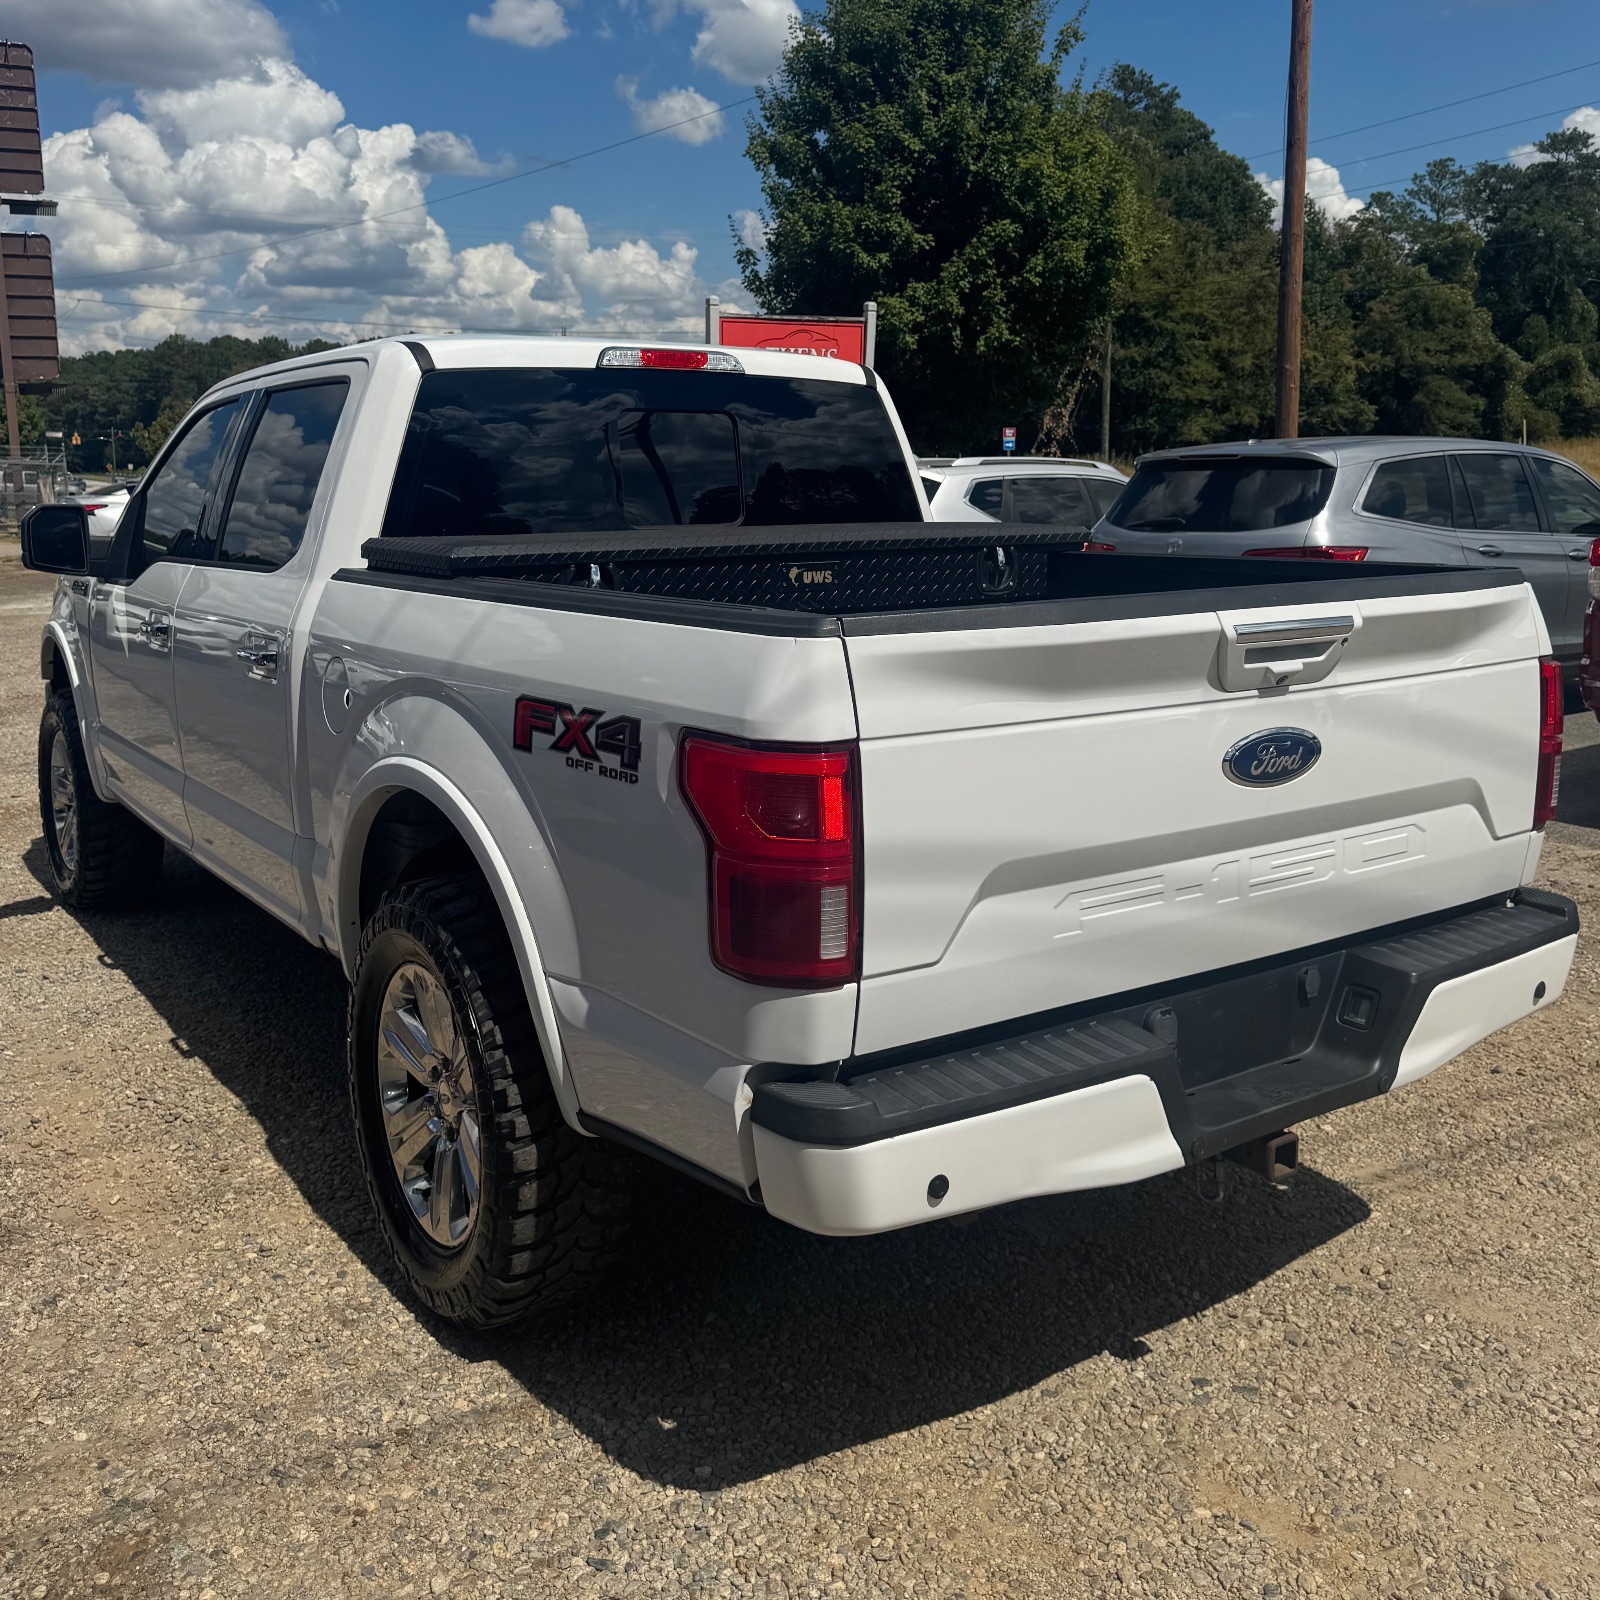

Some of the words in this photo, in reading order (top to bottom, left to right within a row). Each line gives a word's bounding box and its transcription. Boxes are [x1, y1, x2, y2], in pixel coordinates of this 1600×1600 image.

[803, 570, 833, 584] UWS
[513, 693, 642, 773] FX4
[565, 756, 594, 772] OFF
[599, 764, 639, 785] ROAD
[1250, 741, 1304, 776] Ford
[1053, 823, 1427, 939] F-150
